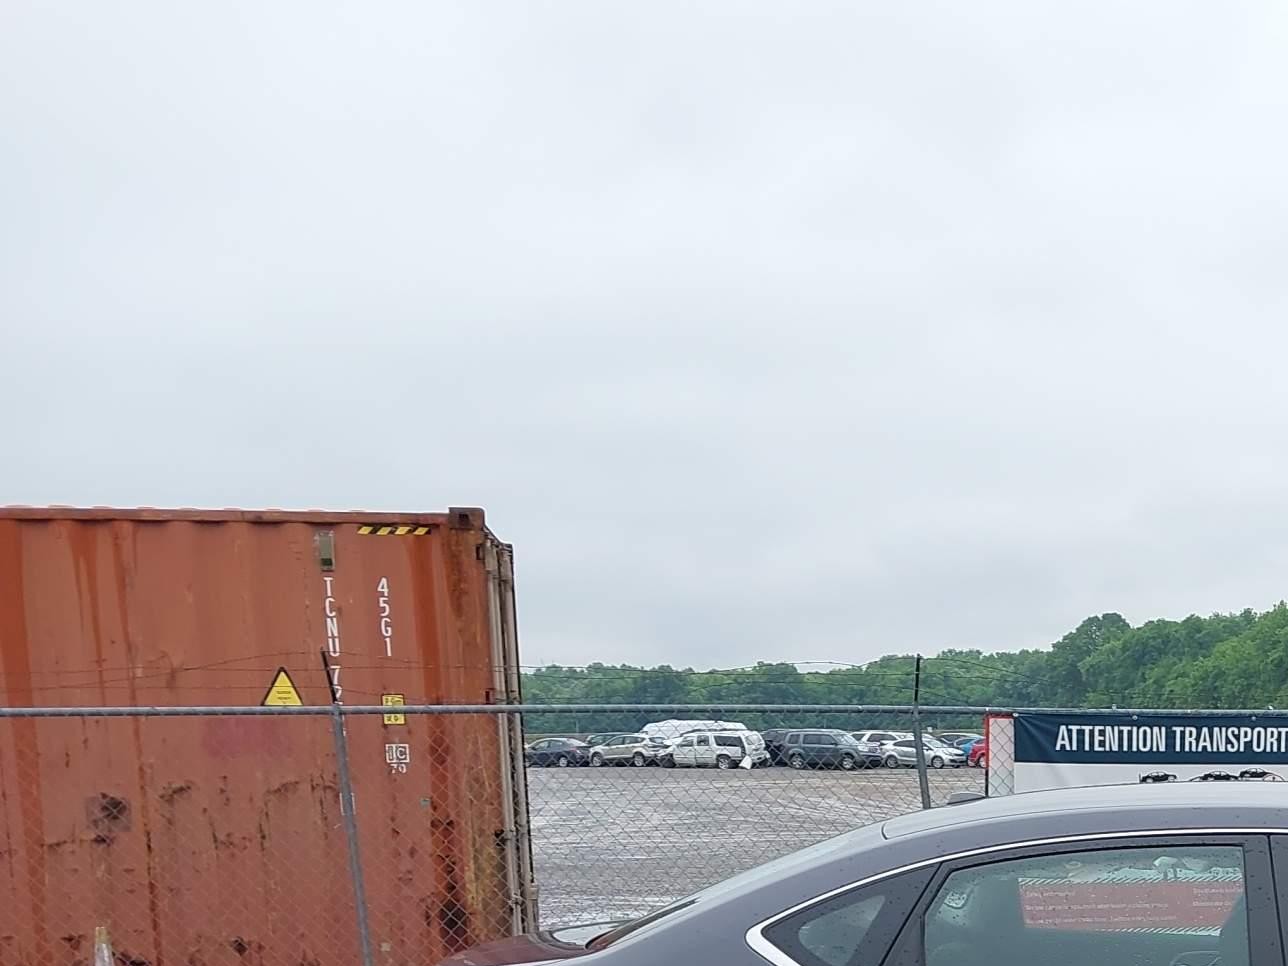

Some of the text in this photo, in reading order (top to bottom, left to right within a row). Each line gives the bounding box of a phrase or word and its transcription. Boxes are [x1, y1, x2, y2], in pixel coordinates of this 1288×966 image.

[323, 577, 340, 657] TCNU
[377, 577, 392, 657] 45G1
[1055, 725, 1166, 752] ATTENTION
